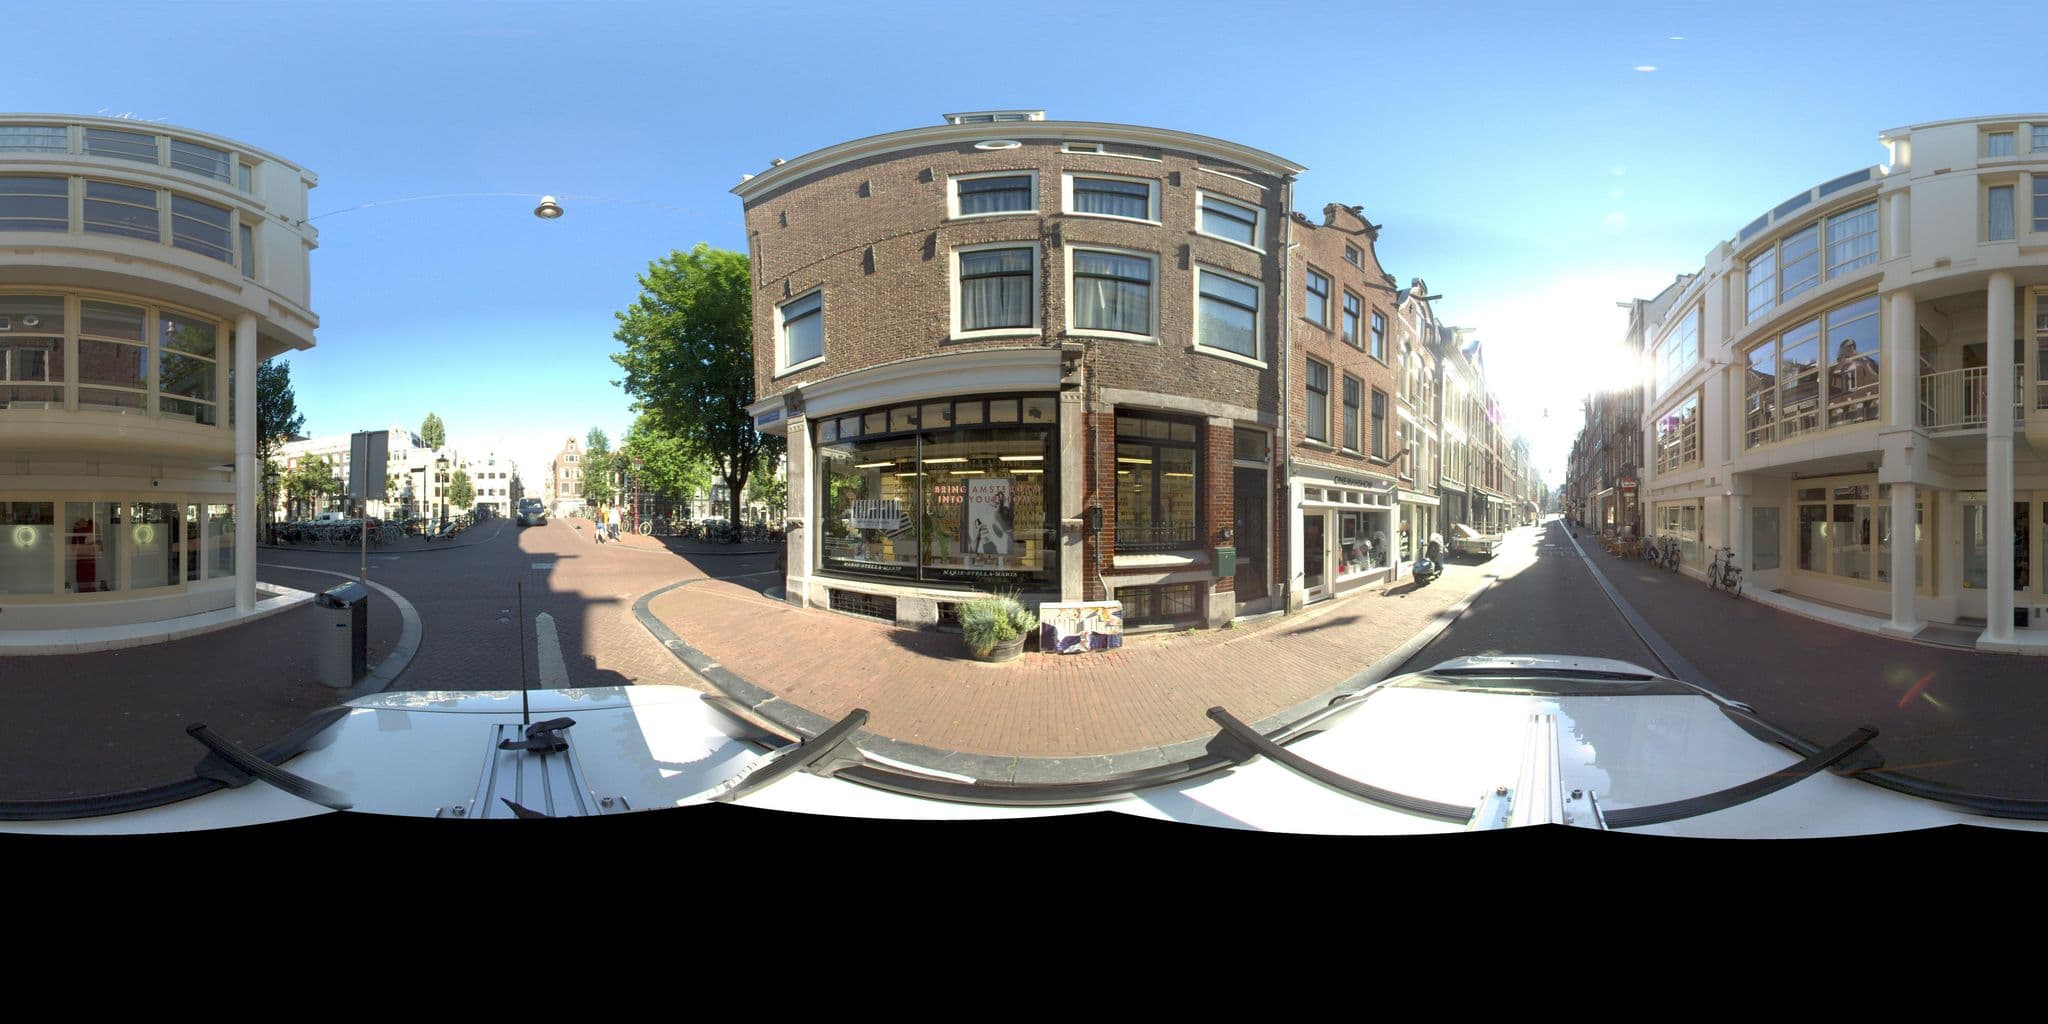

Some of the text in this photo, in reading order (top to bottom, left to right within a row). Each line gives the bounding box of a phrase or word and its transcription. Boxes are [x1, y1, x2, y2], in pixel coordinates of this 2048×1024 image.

[934, 485, 1041, 494] BRING AMSTERDAM
[938, 495, 964, 503] INTO
